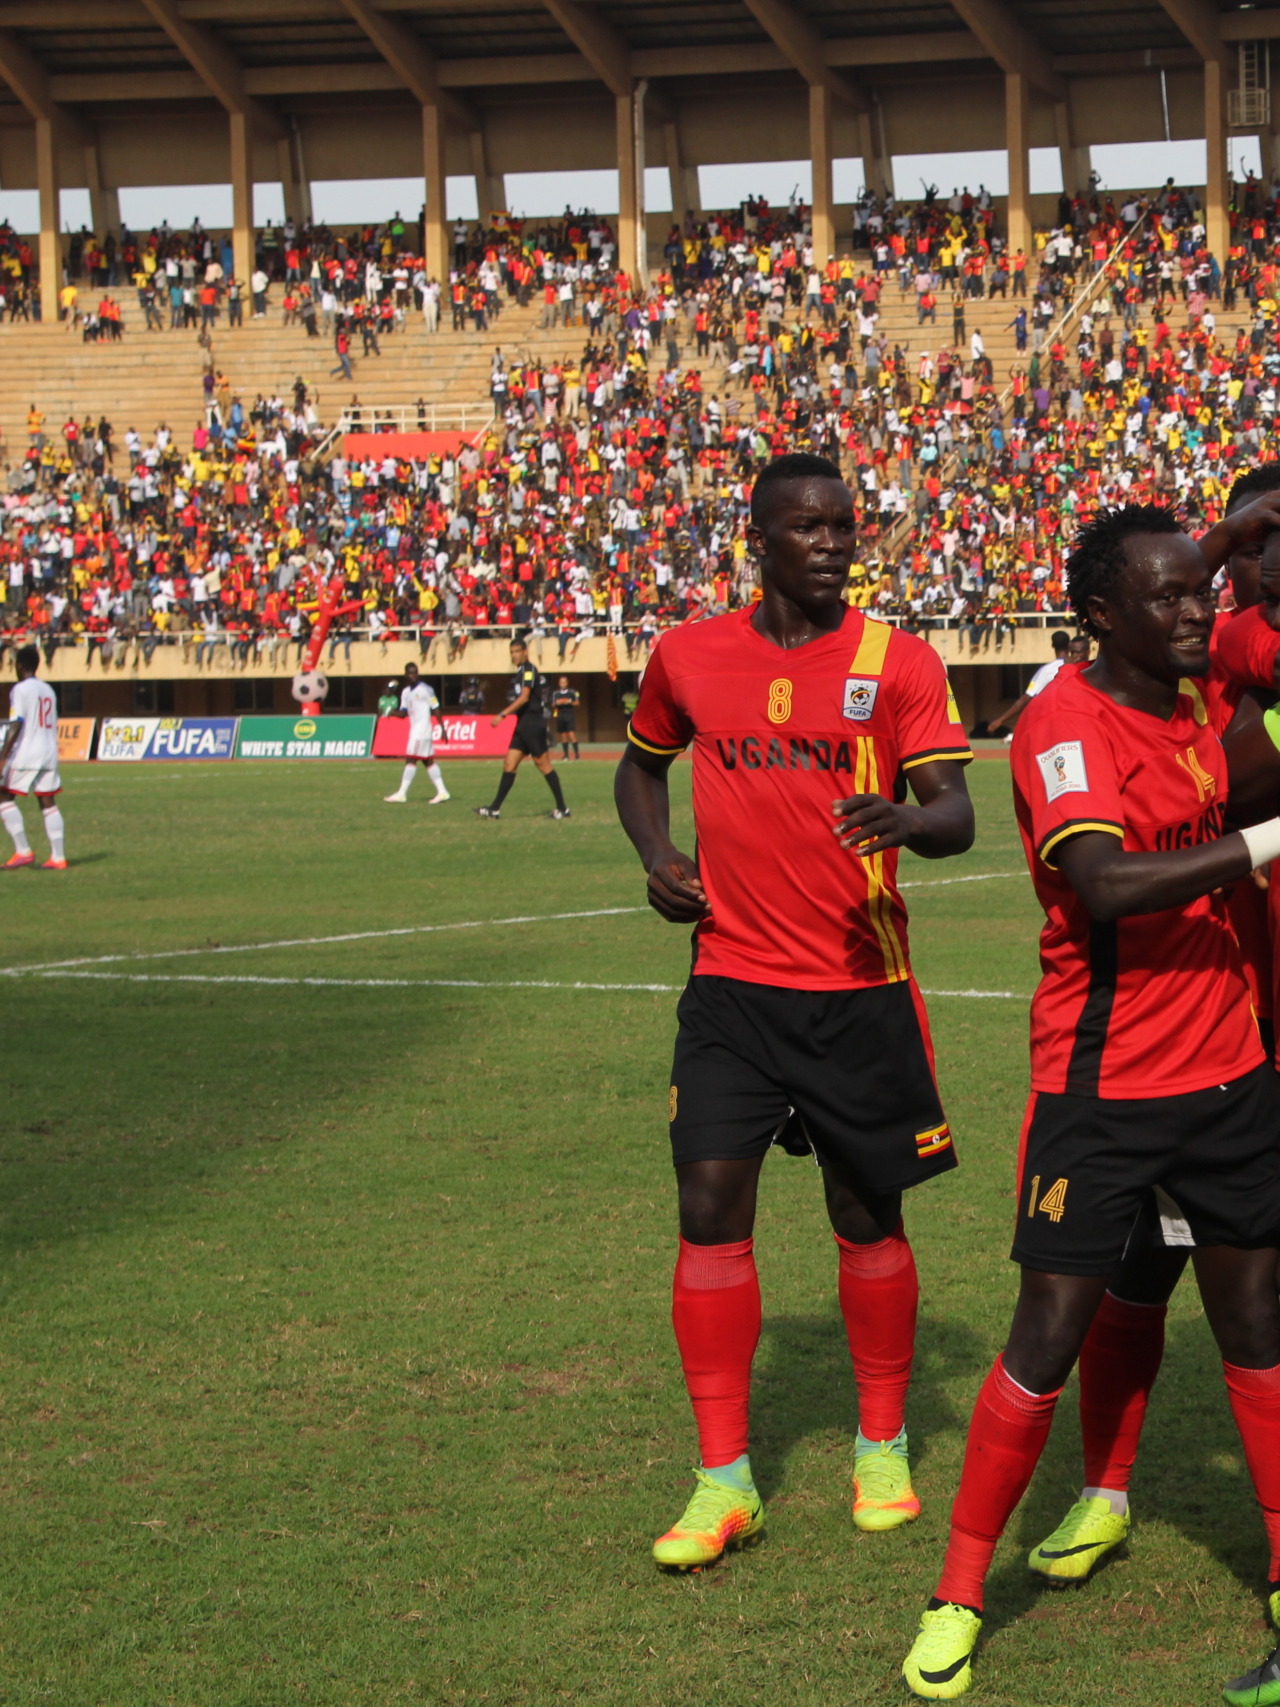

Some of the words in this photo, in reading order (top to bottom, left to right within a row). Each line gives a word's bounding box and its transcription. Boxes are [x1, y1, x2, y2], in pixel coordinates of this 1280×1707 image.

[38, 696, 53, 729] 12
[768, 678, 793, 724] 8
[849, 709, 867, 717] FUFA
[56, 724, 81, 739] ILE
[153, 728, 216, 755] FUFA
[102, 743, 136, 757] FUFA
[241, 741, 284, 756] WHITE
[286, 741, 321, 756] STAR
[324, 741, 366, 756] MAGIC
[716, 736, 852, 774] UGANDA
[1175, 746, 1216, 803] 14
[1027, 1175, 1068, 1223] 14
